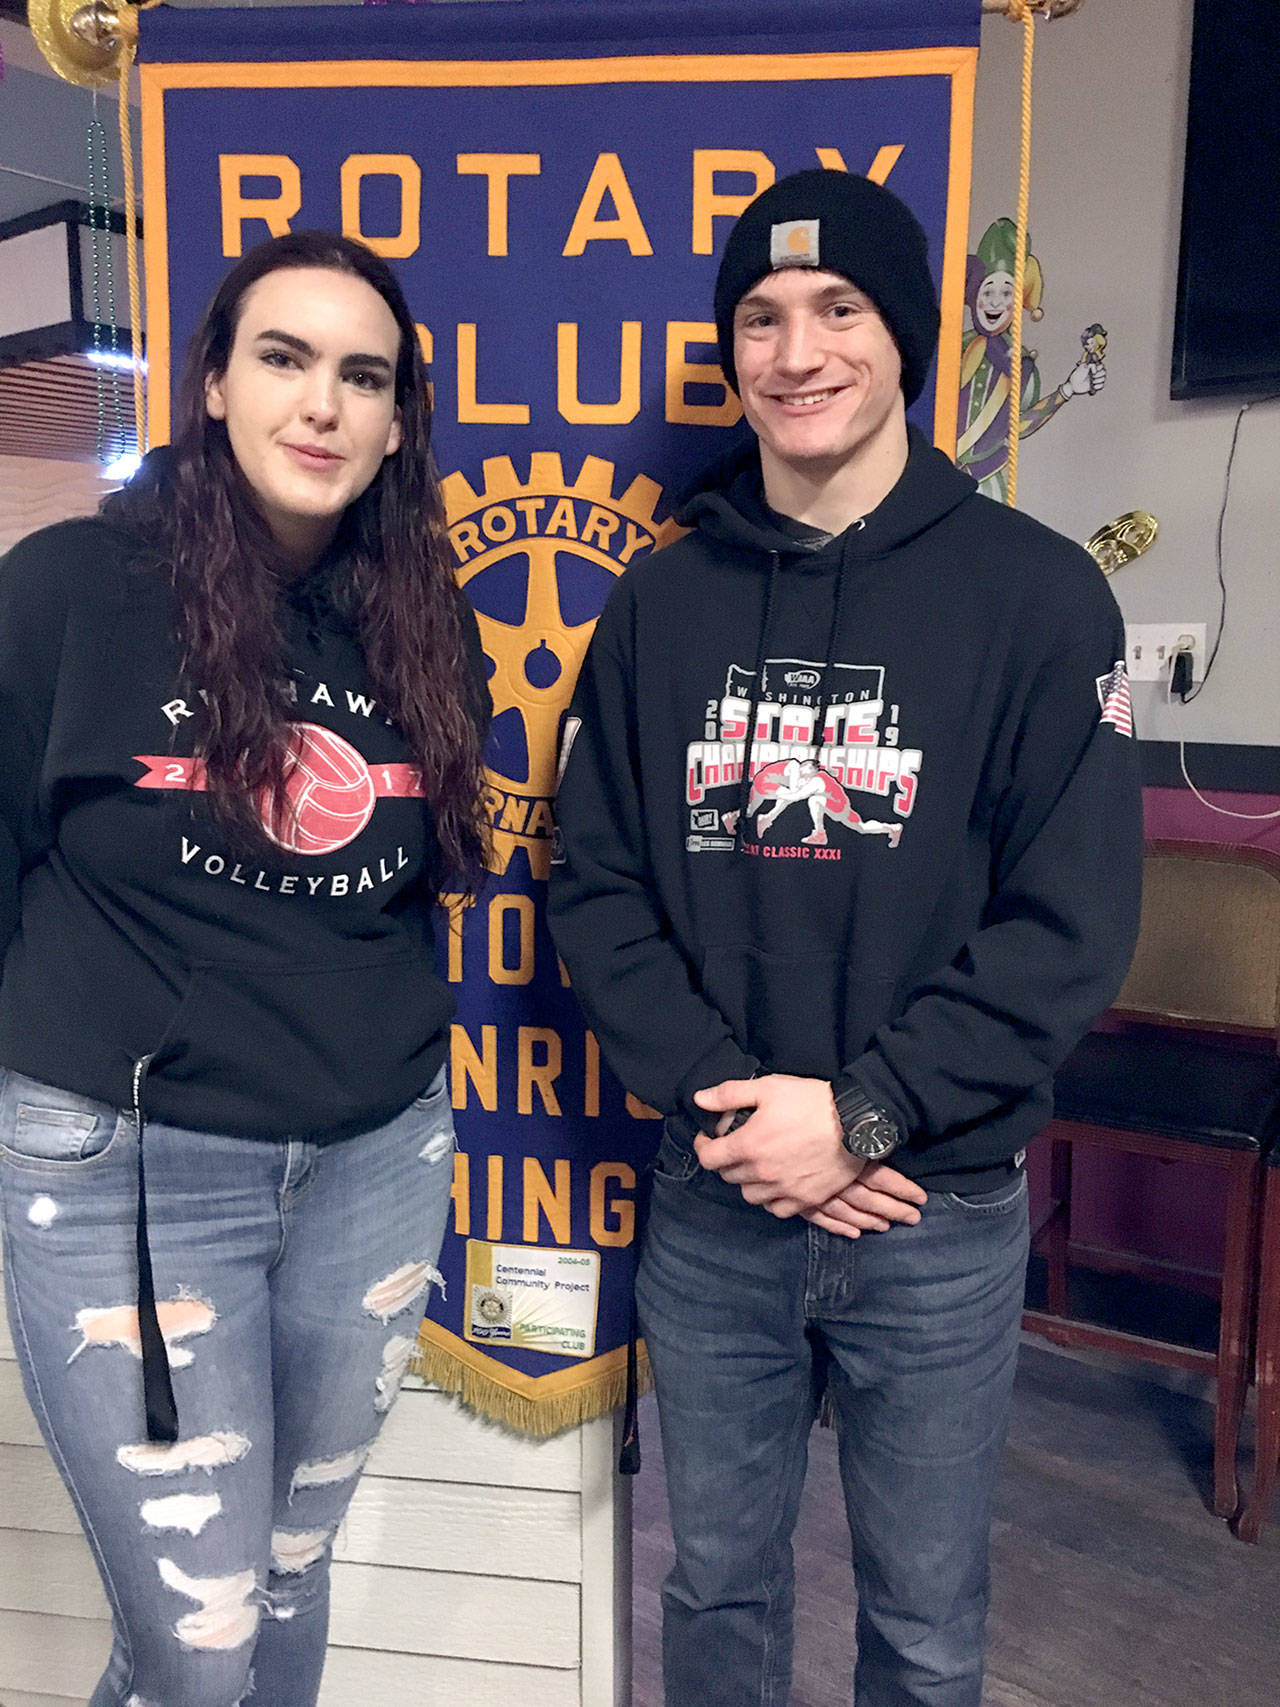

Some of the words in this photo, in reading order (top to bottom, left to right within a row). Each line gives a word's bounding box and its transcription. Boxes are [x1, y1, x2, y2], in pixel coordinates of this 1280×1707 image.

[415, 321, 745, 427] LUB
[448, 498, 654, 563] ROTARY
[736, 686, 870, 706] WSHINTON
[720, 696, 884, 746] STATE
[763, 846, 810, 859] CLASSIC
[813, 848, 841, 860] XXXI
[180, 836, 409, 896] VOLLEYBALL
[496, 1264, 547, 1277] Centennial
[495, 1276, 550, 1290] Community
[555, 1281, 590, 1292] Project
[519, 1323, 586, 1338] PARTICIPATING
[561, 1340, 585, 1350] CLUB
